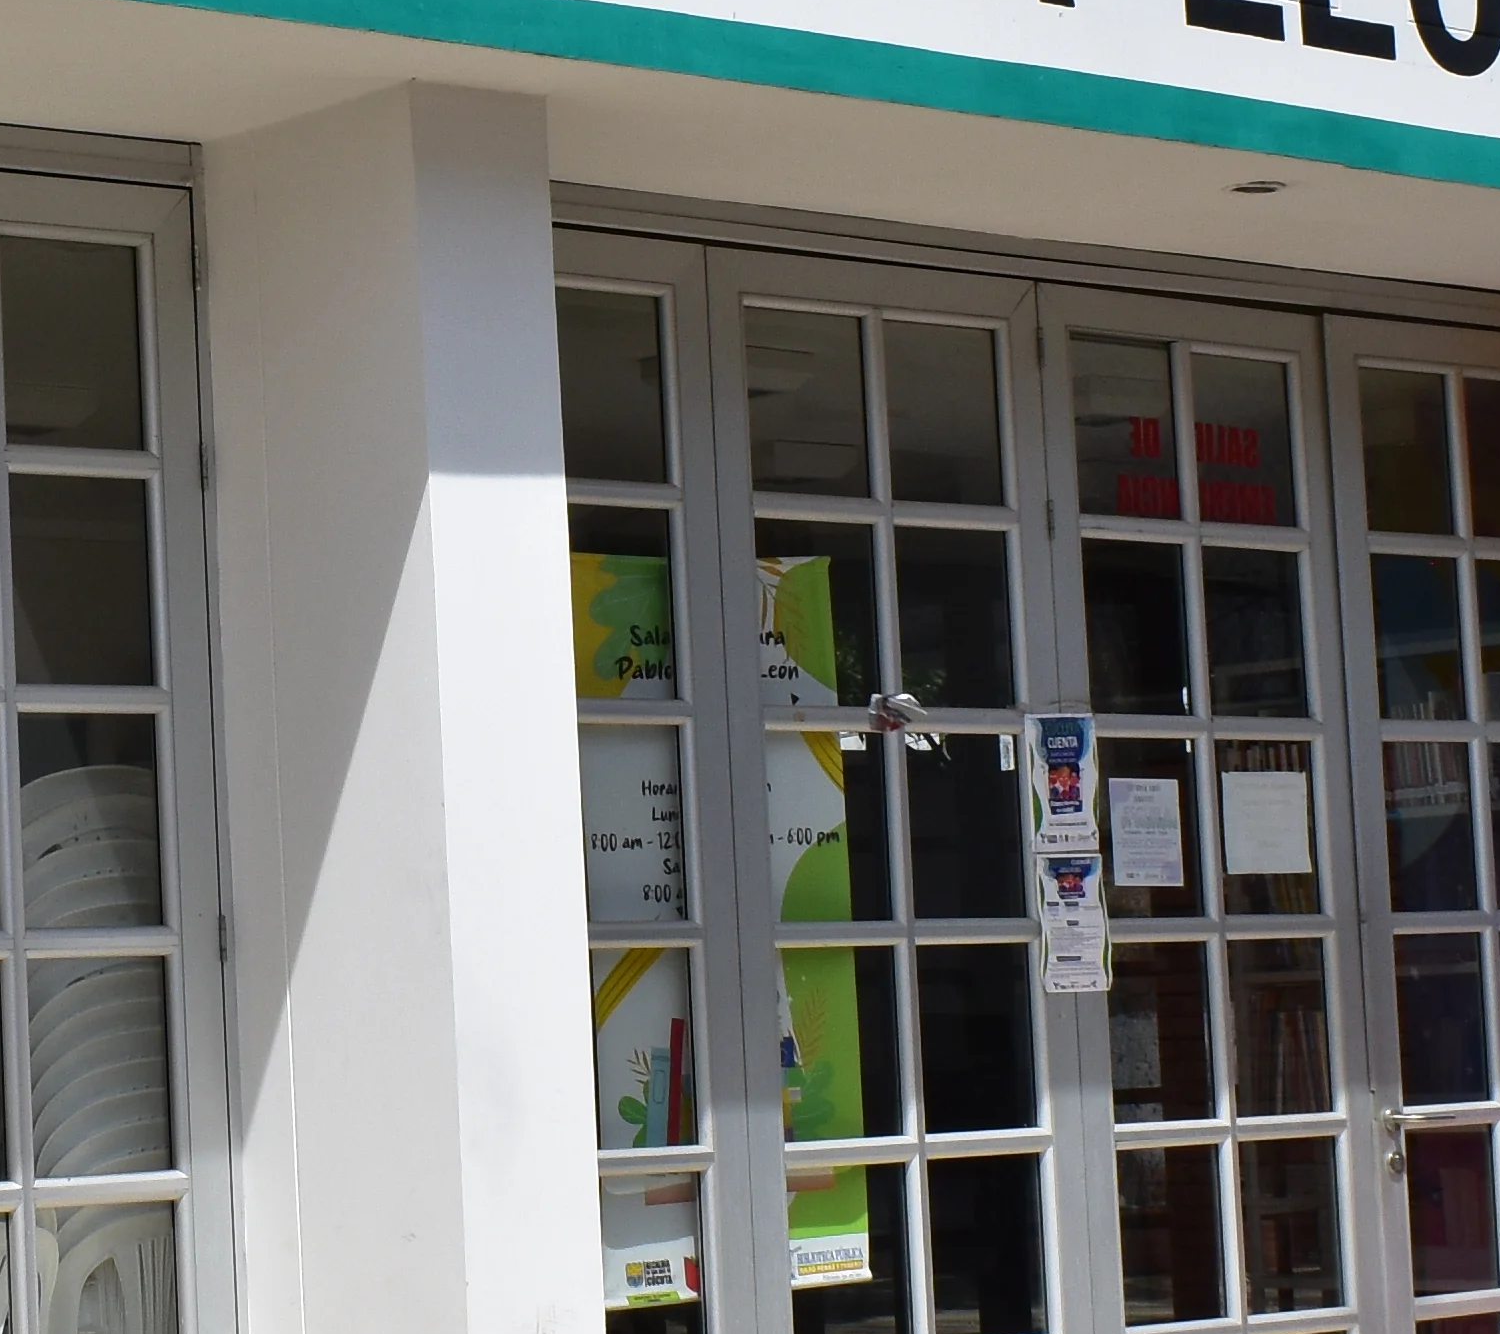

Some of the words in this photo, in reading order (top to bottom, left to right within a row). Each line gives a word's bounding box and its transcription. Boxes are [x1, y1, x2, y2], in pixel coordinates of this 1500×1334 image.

[622, 837, 643, 851] am
[786, 827, 812, 846] 6:00
[816, 830, 840, 848] pm
[642, 883, 672, 903] 8:00
